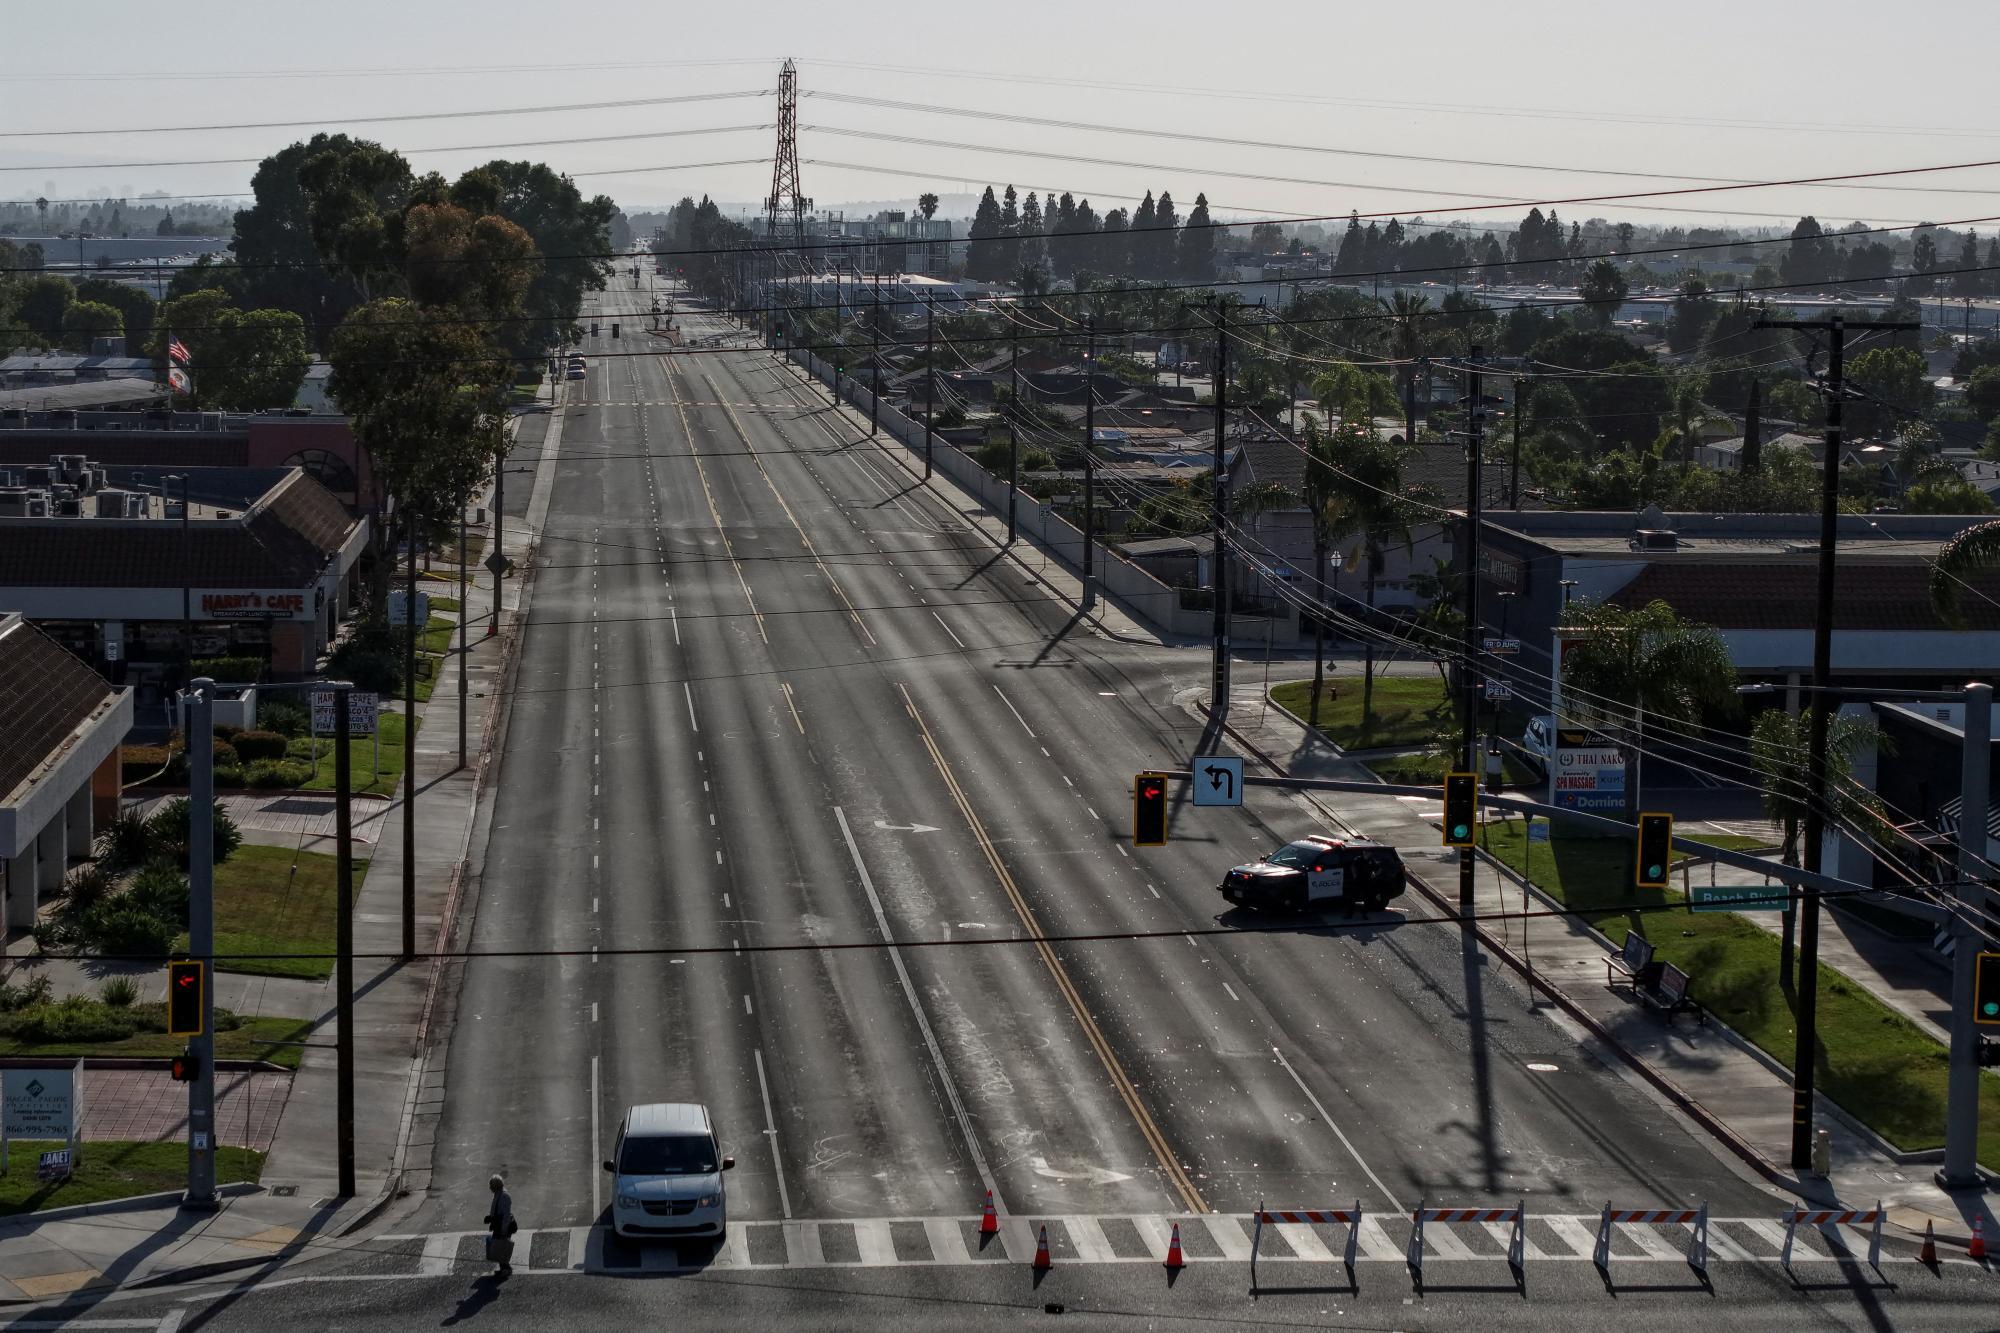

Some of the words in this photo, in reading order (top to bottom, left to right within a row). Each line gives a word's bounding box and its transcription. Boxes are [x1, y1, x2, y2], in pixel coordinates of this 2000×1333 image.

[202, 592, 262, 611] HARRY'S
[267, 594, 304, 612] CAFE
[1577, 754, 1597, 764] THAI
[1601, 754, 1624, 764] NAKO
[1555, 776, 1567, 789] SPA
[1569, 776, 1596, 789] MASSAGE
[1577, 795, 1625, 808] Domino
[1703, 892, 1745, 905] Beach
[1749, 892, 1778, 905] Blvd
[40, 1151, 69, 1166] JANET
